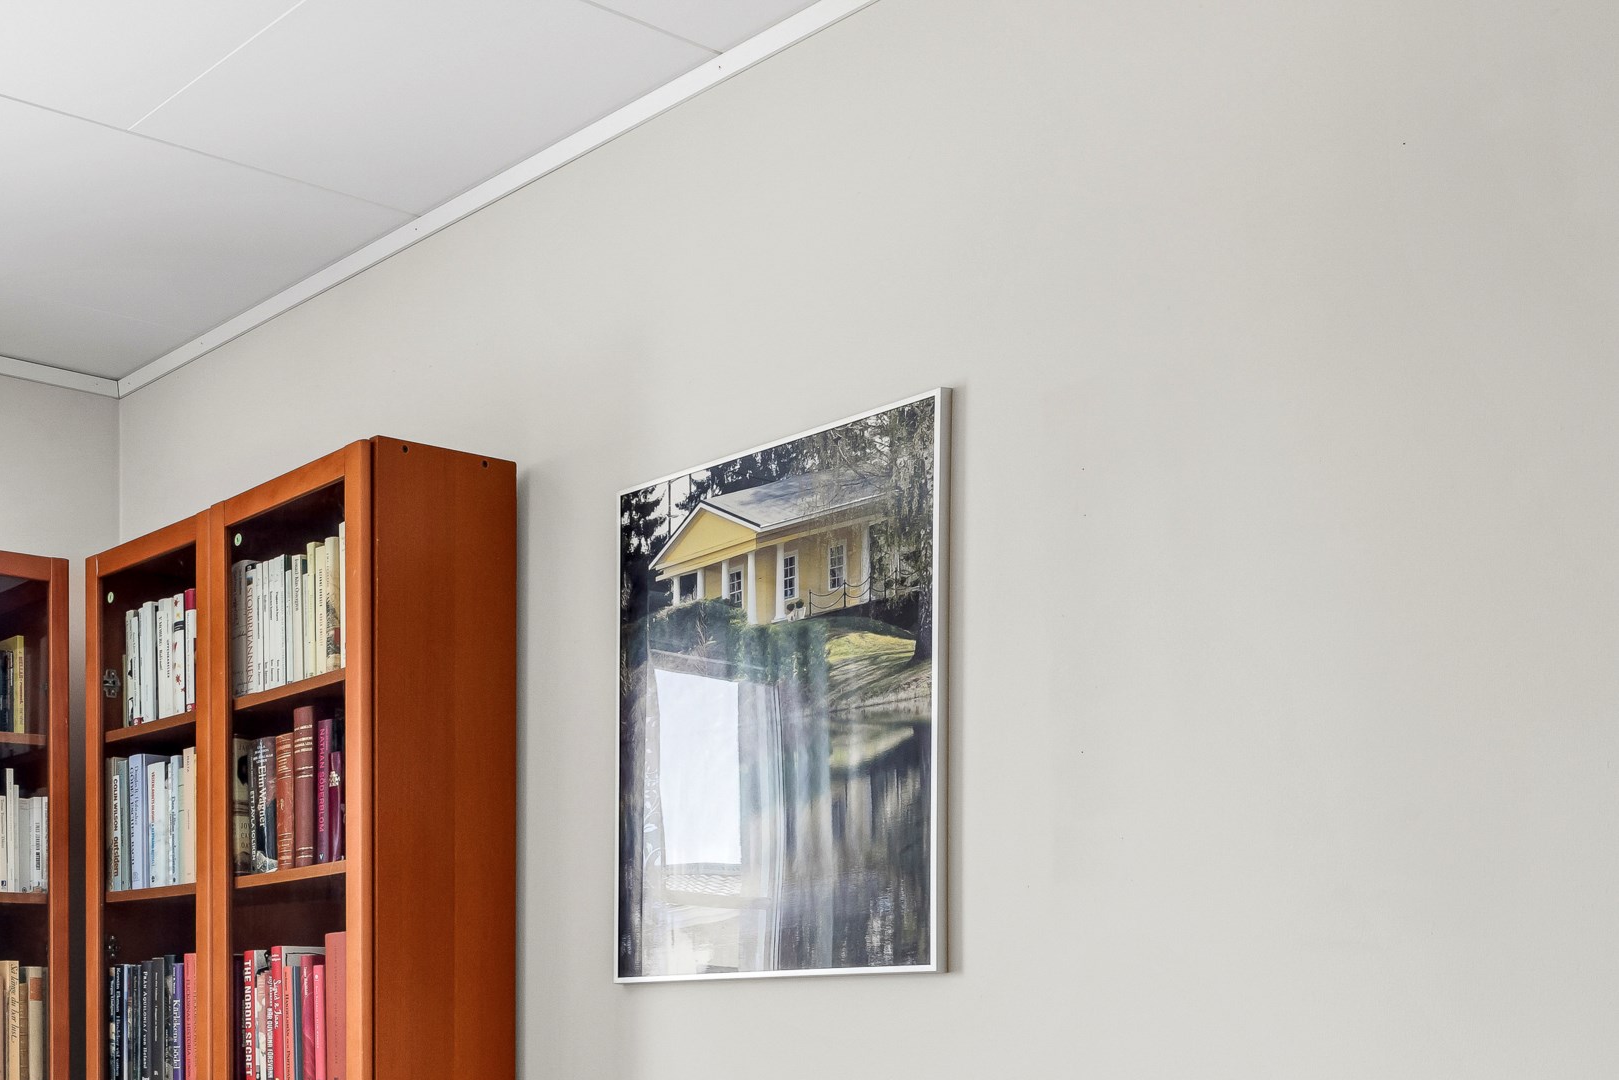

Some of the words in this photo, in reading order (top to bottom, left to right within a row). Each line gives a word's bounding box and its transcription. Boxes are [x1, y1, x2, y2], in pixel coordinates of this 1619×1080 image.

[257, 766, 267, 787] Elin
[10, 964, 18, 976] Så
[244, 960, 252, 983] THE
[9, 976, 18, 995] länge
[9, 997, 18, 1007] du
[244, 986, 252, 1028] NORDIC
[9, 1009, 18, 1022] har
[173, 1000, 181, 1043] Kärlekens
[173, 1045, 181, 1069] bödel
[244, 1032, 252, 1077] SECRET
